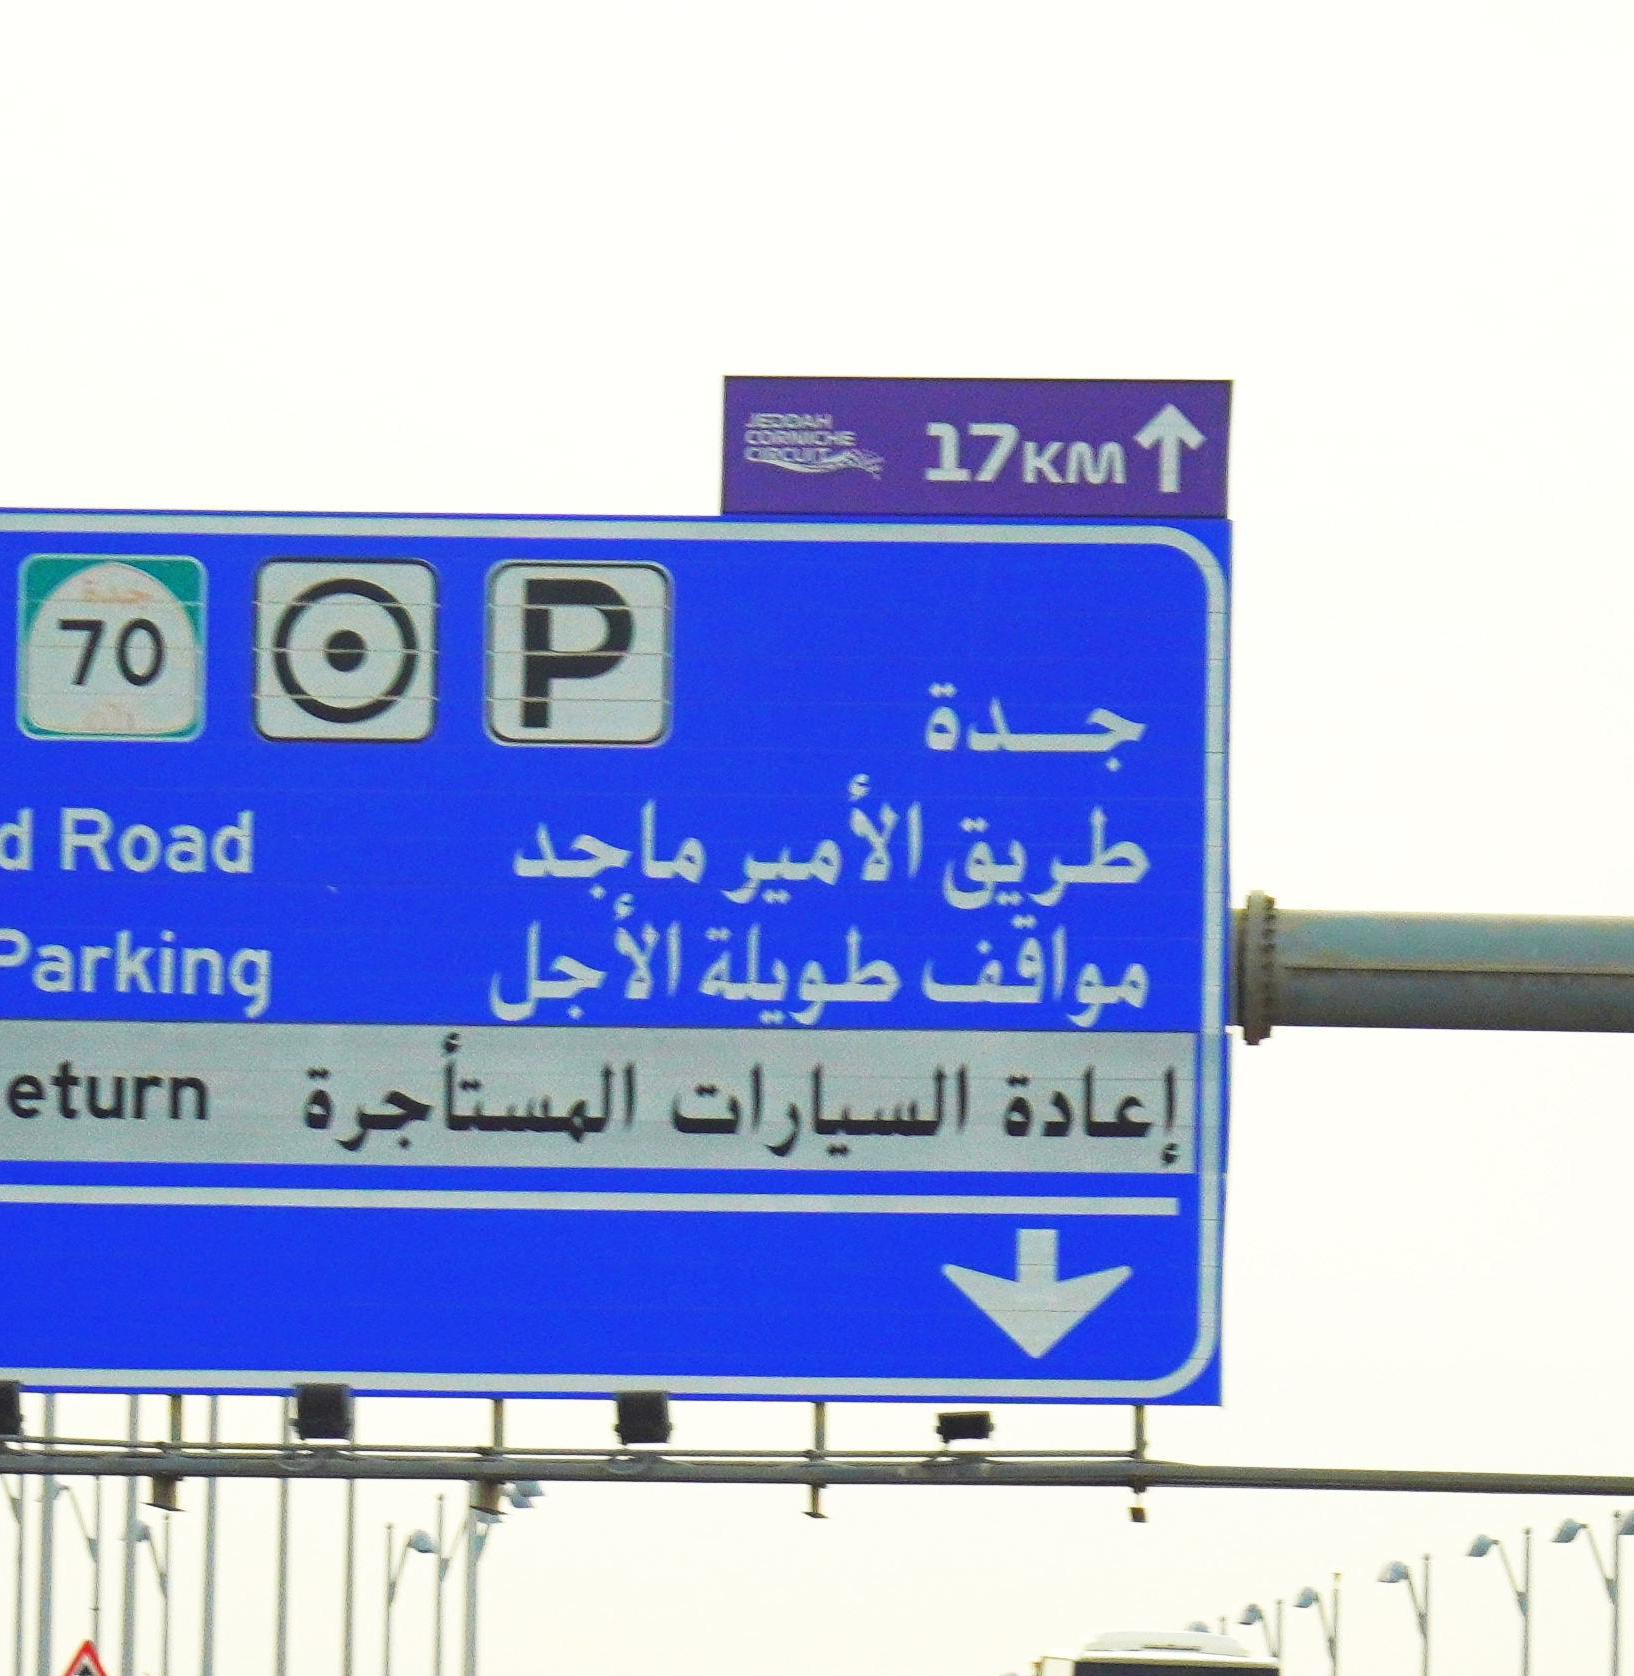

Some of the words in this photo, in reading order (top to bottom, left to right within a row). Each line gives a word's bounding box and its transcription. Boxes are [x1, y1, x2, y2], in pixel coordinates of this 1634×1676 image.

[744, 429, 859, 446] CORNICHE
[744, 447, 831, 464] CIRCUIT
[746, 412, 833, 429] JEDDAH
[58, 617, 166, 687] 70
[519, 578, 635, 729] P
[924, 682, 1145, 771] جدة
[60, 806, 255, 874] Road
[513, 800, 706, 899] ماجد
[721, 773, 923, 905] الأمير
[941, 806, 1150, 910] طريق
[489, 892, 681, 1022] الأجل
[699, 926, 901, 1027] طويلة
[921, 914, 1149, 1028] مواقف
[302, 1031, 637, 1152] المستأجرة
[670, 1063, 969, 1157] السيارات
[1002, 1064, 1179, 1166] إعادة
